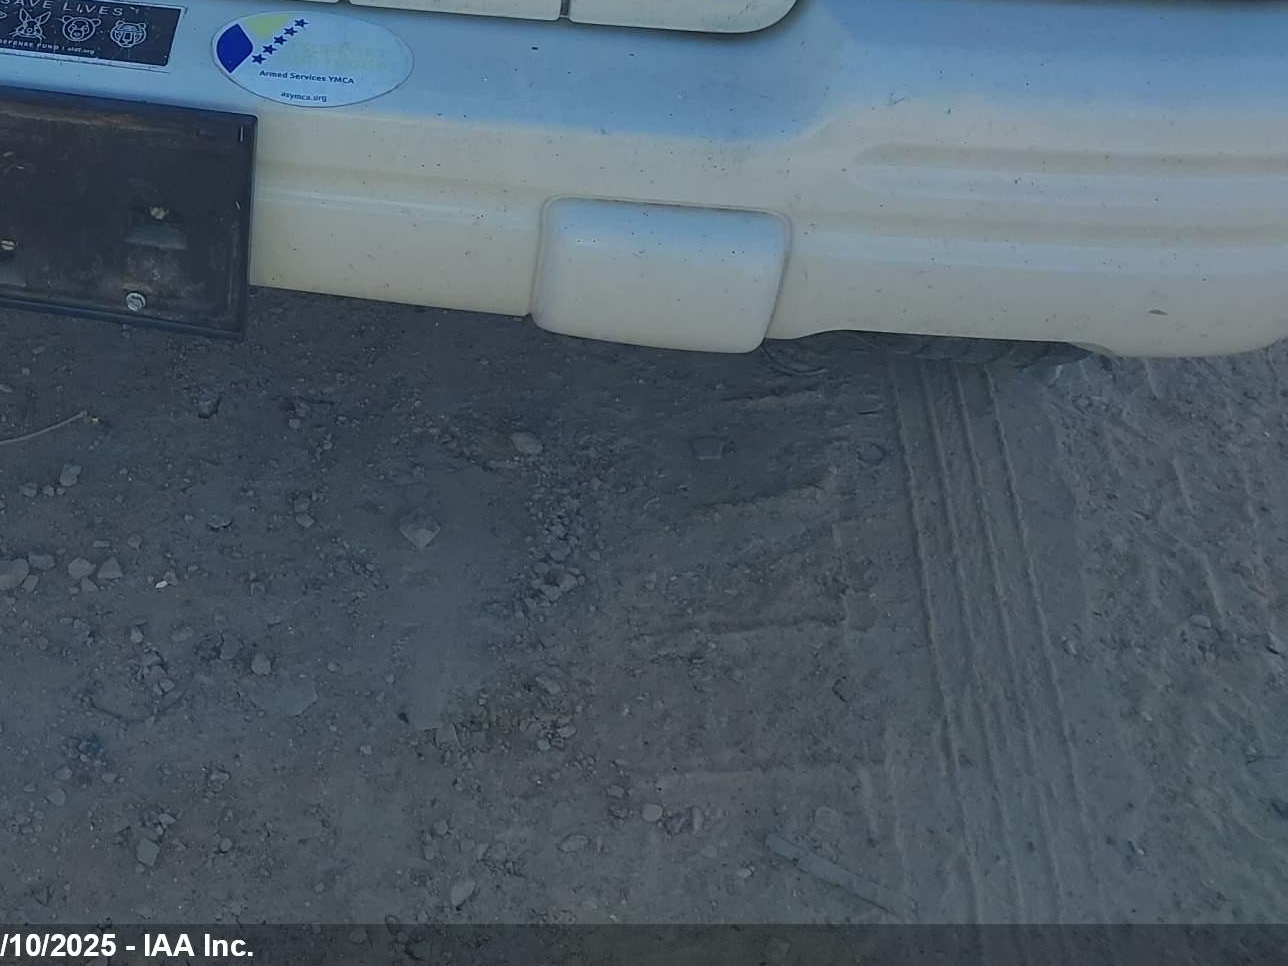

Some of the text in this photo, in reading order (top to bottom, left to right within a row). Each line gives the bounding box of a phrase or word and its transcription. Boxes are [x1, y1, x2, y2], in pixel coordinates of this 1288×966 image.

[63, 2, 124, 16] LIVES
[258, 69, 355, 84] Armed Services YMCA
[280, 91, 327, 103] asymca.org
